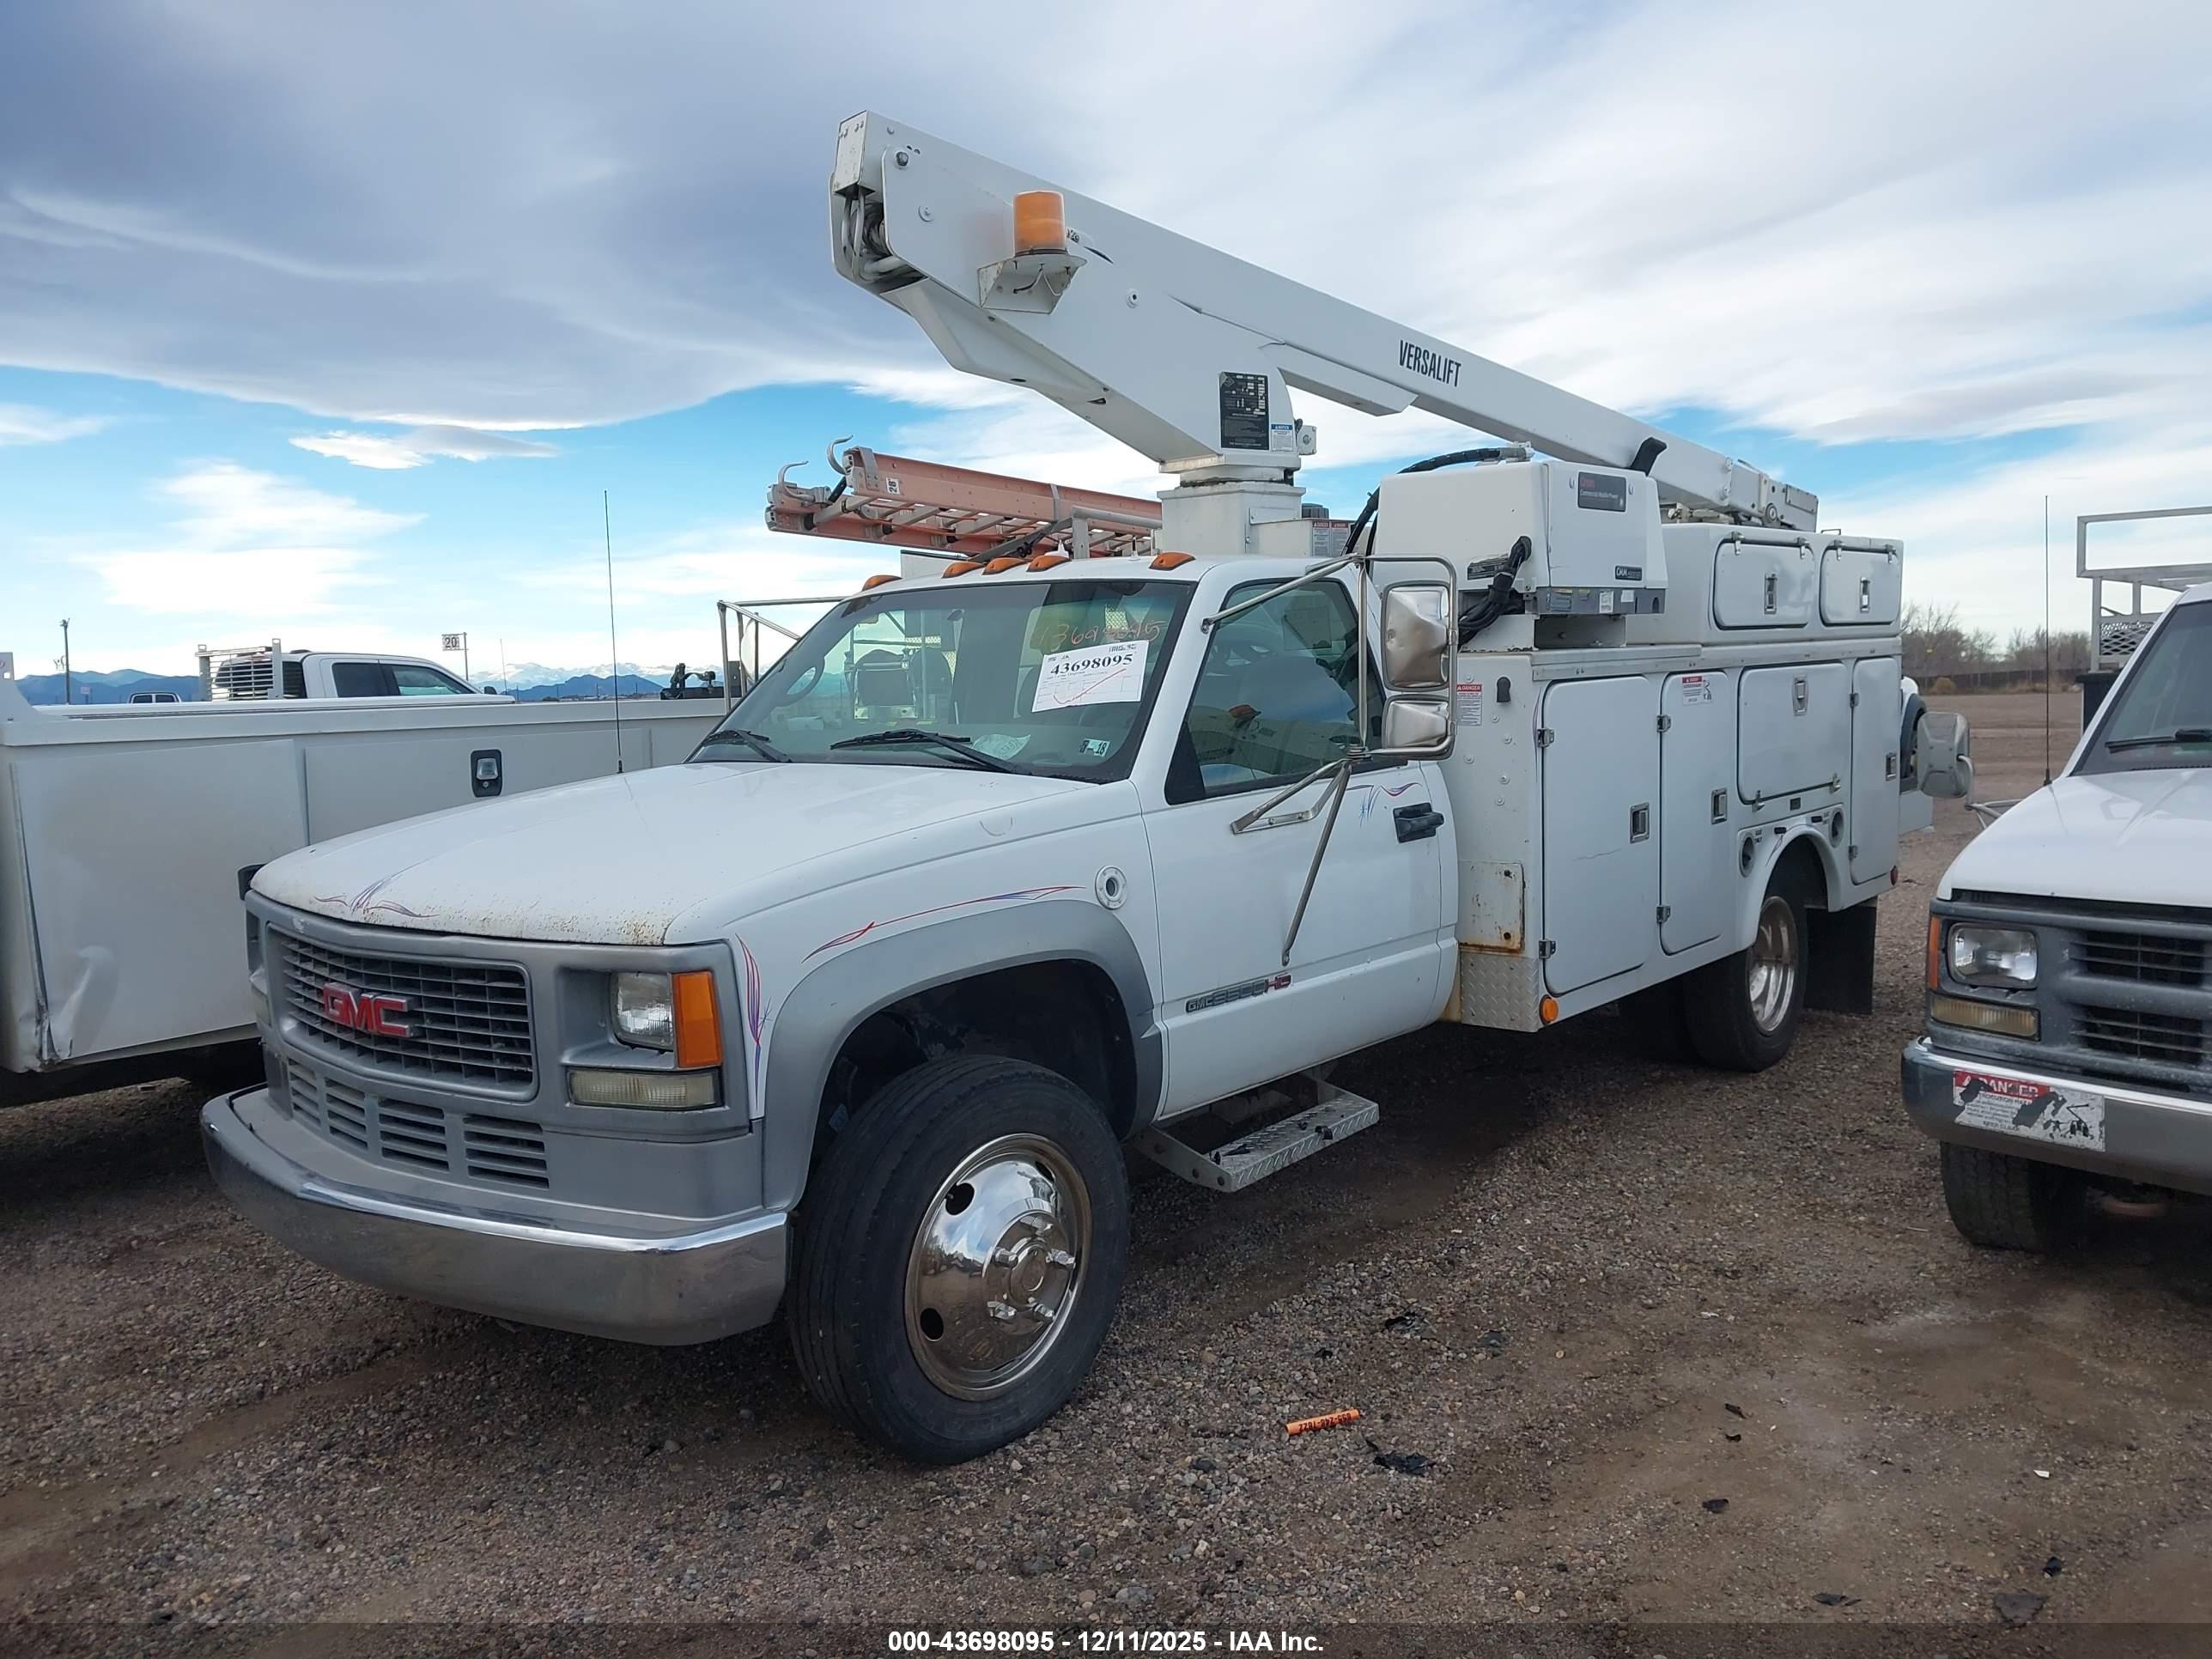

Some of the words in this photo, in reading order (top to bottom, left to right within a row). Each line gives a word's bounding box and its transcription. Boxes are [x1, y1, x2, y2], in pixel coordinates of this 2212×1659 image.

[1399, 339, 1462, 387] VERSALIFT
[445, 636, 457, 648] 20
[1050, 653, 1133, 675] 43698095
[1095, 741, 1108, 756] 18
[323, 982, 410, 1037] GMC
[1188, 996, 1212, 1012] GMC
[1298, 1413, 1352, 1431] 855-248-7822
